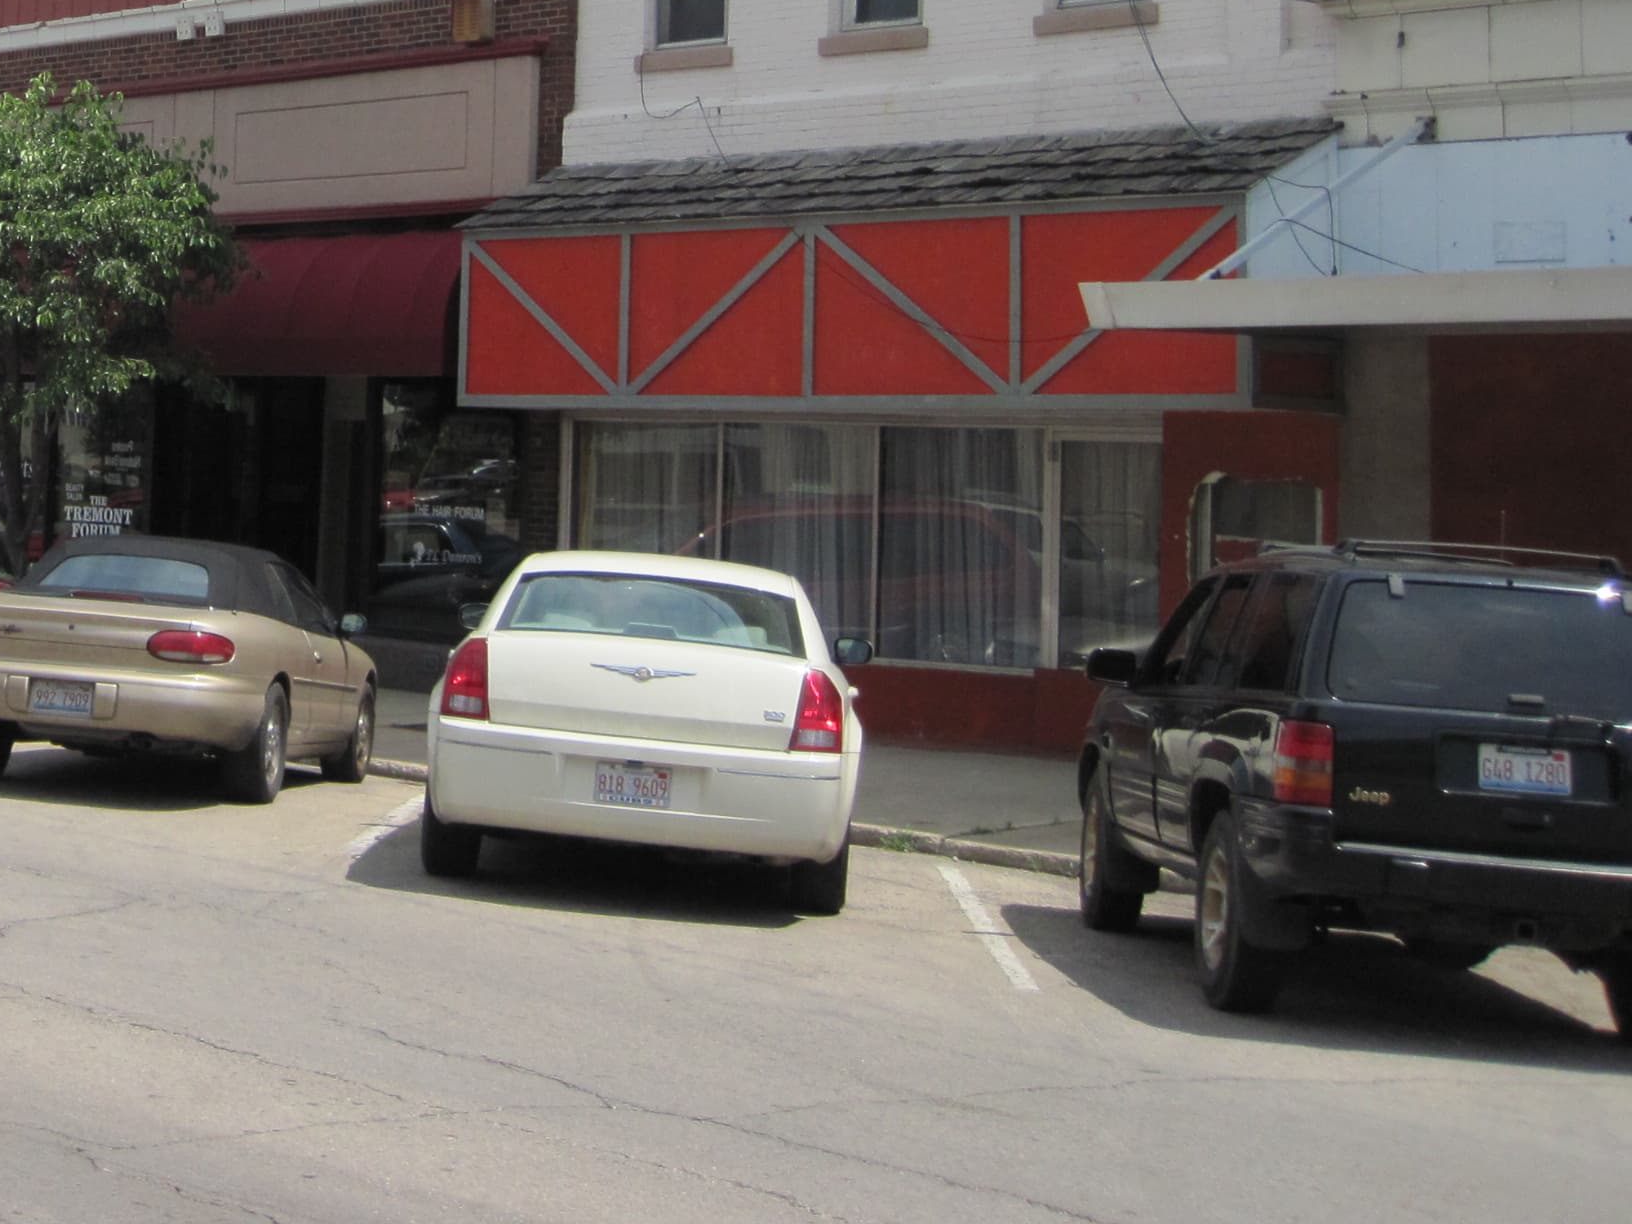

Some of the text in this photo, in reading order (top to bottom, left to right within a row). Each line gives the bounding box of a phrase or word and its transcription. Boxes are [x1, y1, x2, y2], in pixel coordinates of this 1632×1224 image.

[89, 495, 107, 506] THE
[64, 505, 134, 525] TREMONT
[414, 504, 485, 521] THE HAIR FORUM
[71, 523, 121, 538] FORUM
[1482, 757, 1567, 785] G48 1280
[598, 773, 668, 798] 818 9609
[1349, 786, 1392, 805] Jeep
